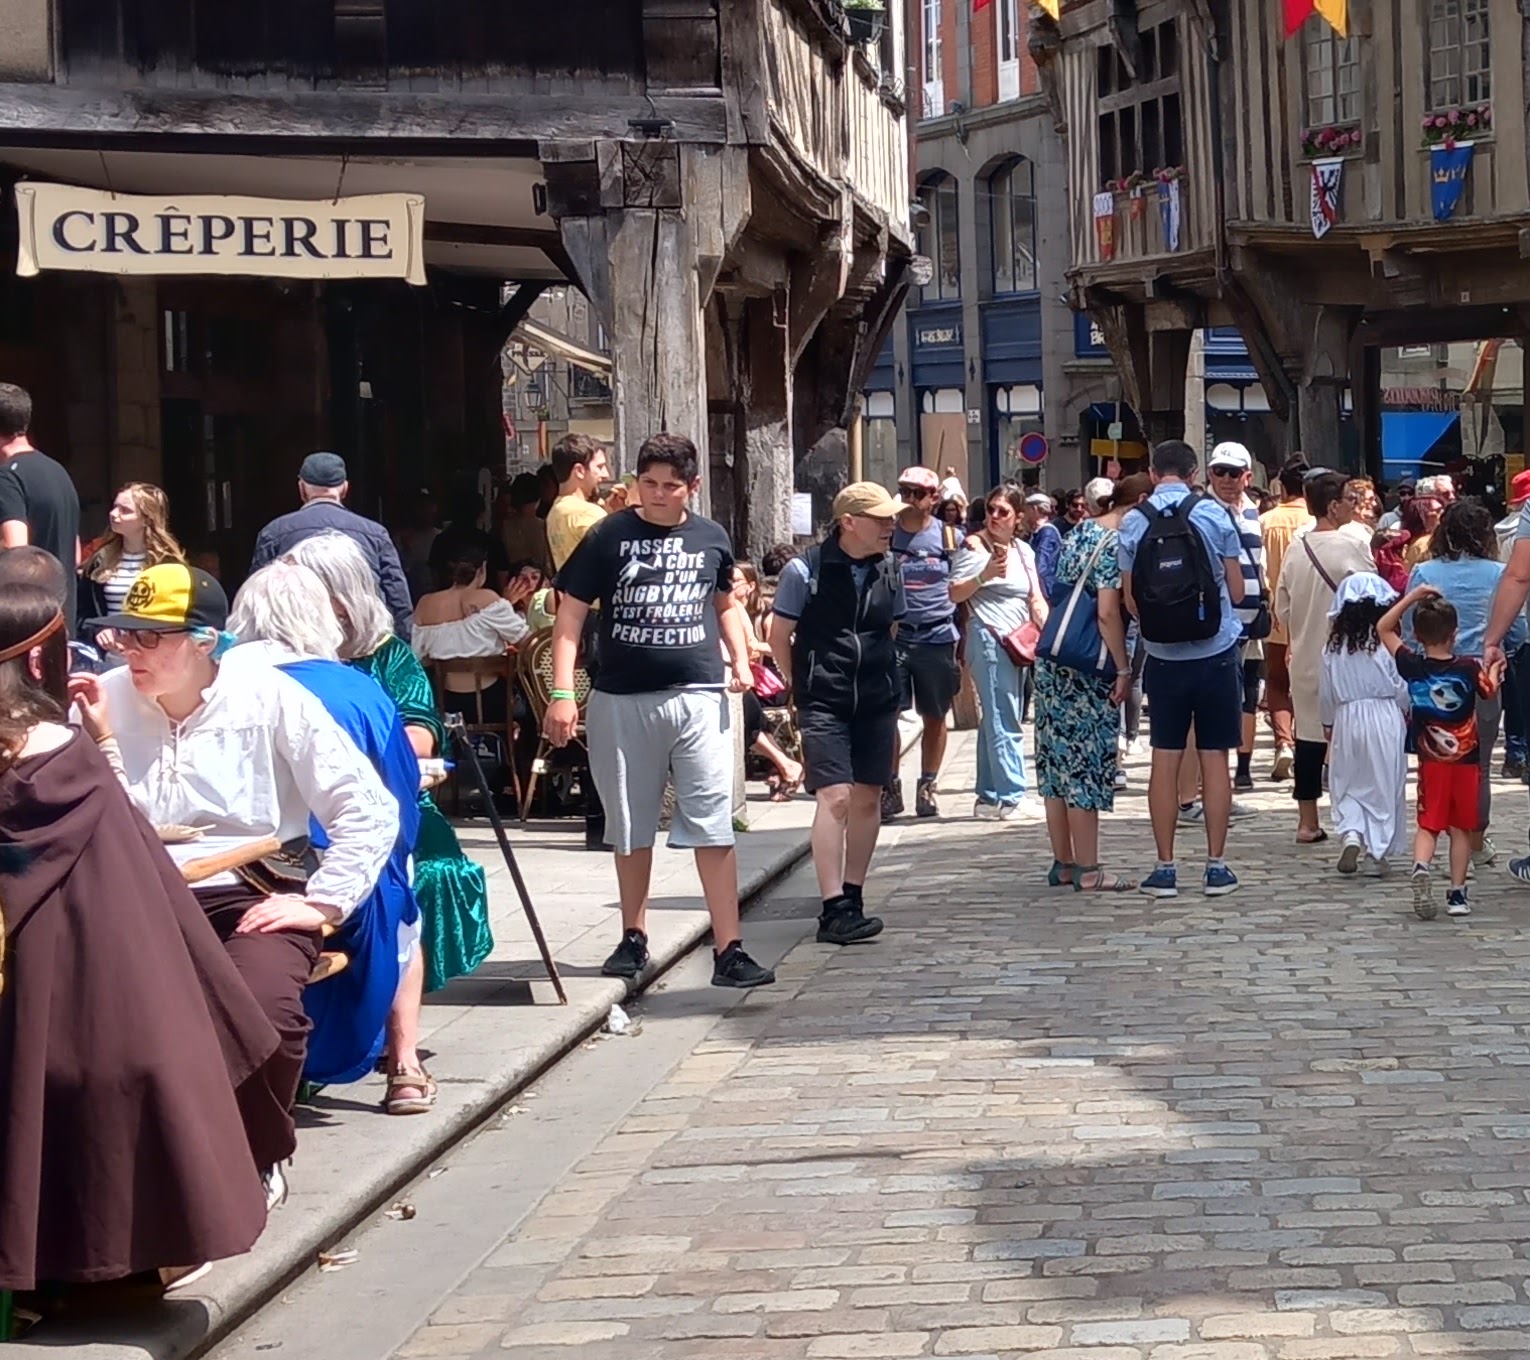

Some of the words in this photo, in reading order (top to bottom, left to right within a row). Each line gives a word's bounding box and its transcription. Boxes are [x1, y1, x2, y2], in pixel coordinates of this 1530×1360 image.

[52, 206, 393, 259] CRÊPERIE
[620, 538, 683, 557] PASSER
[664, 570, 697, 584] D'UN
[612, 582, 712, 604] RUGBYMAN
[613, 606, 642, 619] C'EST
[612, 623, 706, 645] PERFECTION
